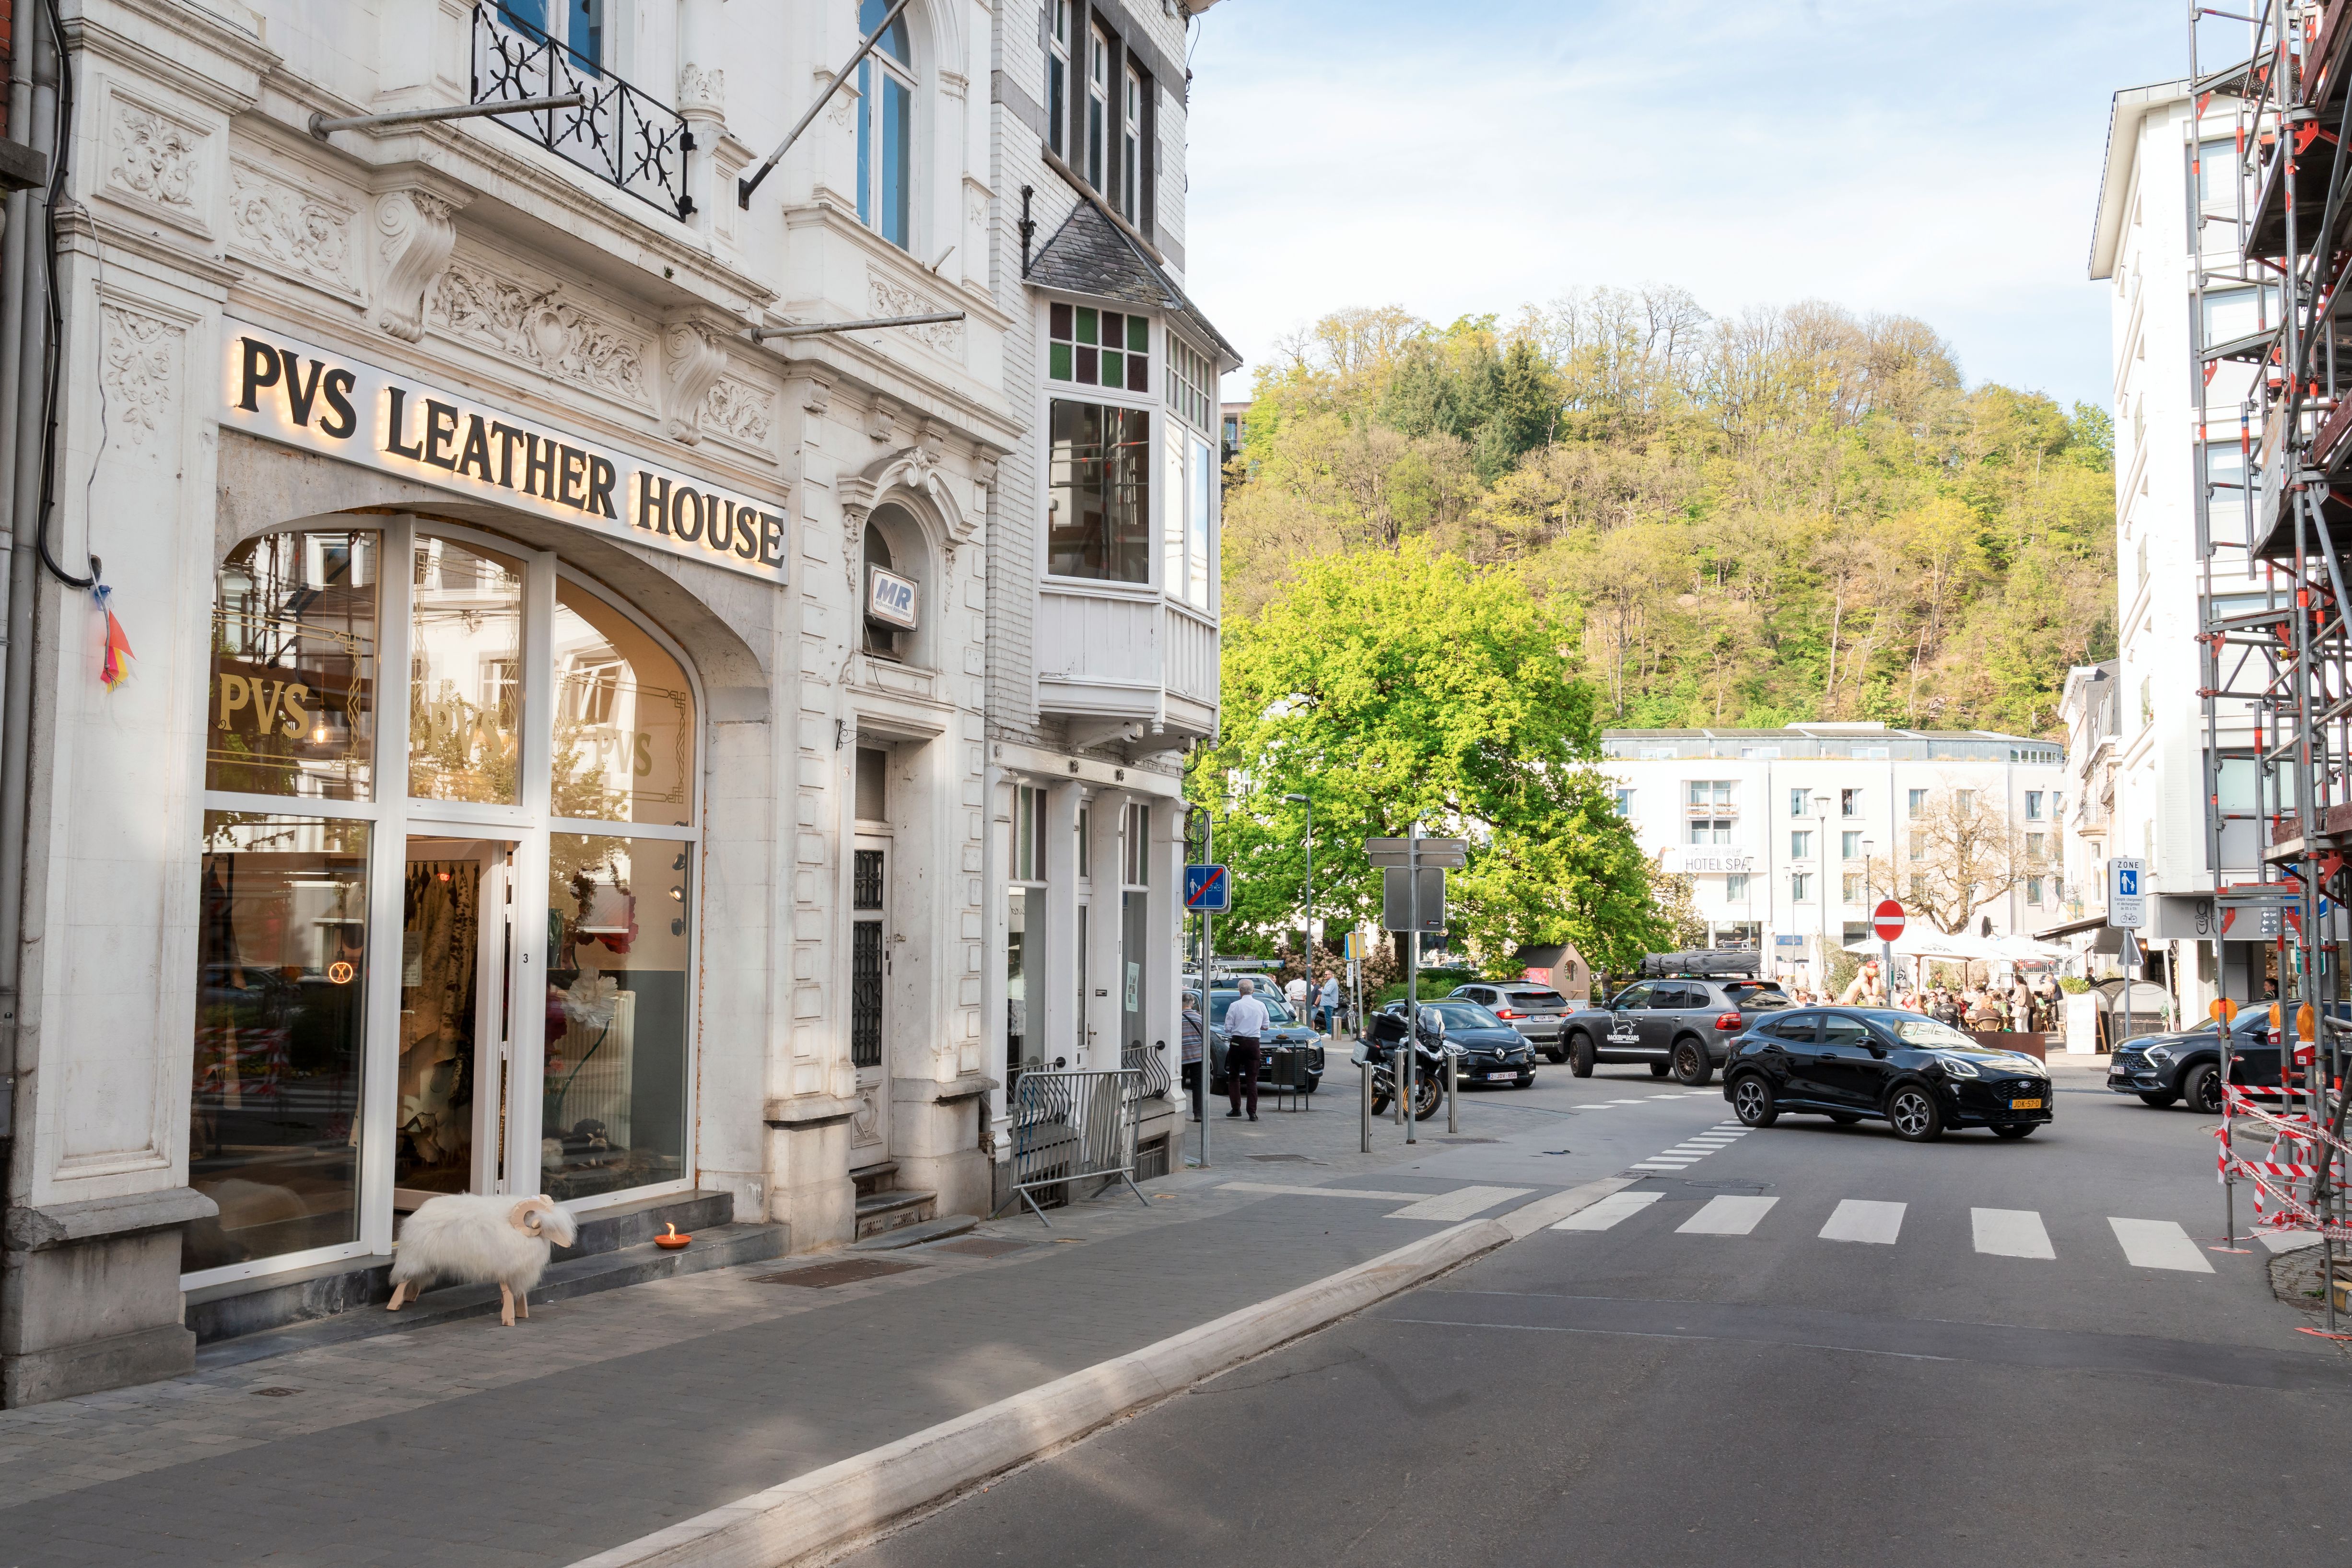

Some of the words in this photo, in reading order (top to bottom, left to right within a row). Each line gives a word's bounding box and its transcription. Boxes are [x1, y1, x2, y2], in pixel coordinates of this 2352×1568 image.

[239, 337, 356, 438] PVS
[385, 386, 617, 519] LEATHER
[637, 471, 785, 569] HOUSE
[876, 578, 911, 611] MR
[217, 673, 309, 739] PVS
[429, 702, 502, 760] PVS
[595, 726, 652, 777] PVS
[1686, 858, 1722, 870] HOTEL
[523, 953, 528, 963] 3
